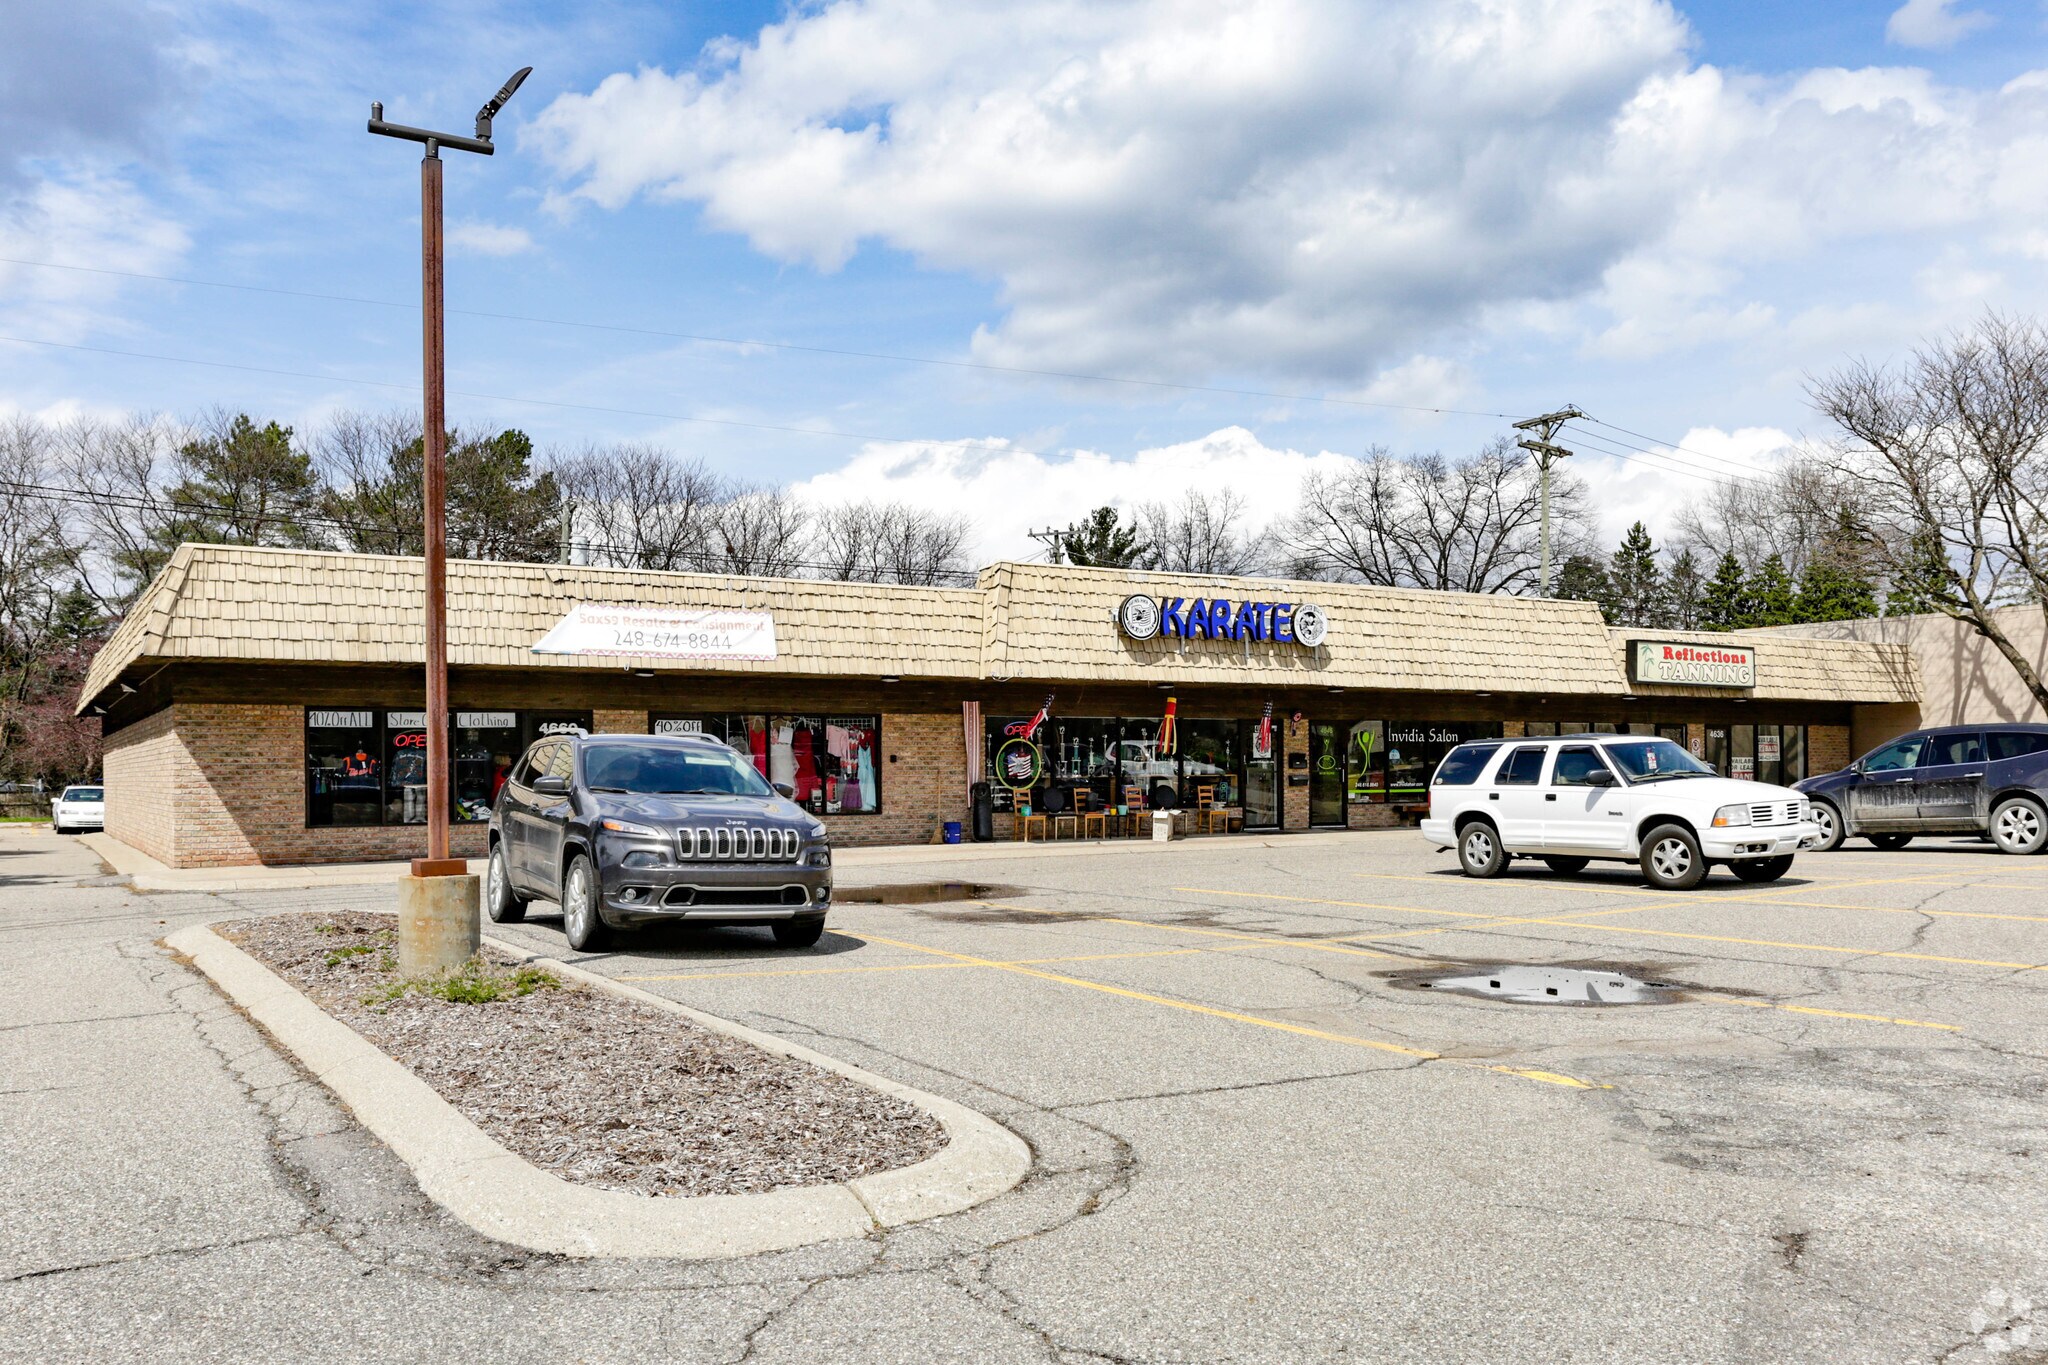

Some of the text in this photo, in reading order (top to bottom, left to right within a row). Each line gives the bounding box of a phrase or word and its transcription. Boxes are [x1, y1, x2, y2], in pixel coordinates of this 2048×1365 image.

[1161, 597, 1293, 642] KARATE
[613, 629, 733, 650] 248-674-8844
[1663, 646, 1746, 664] Reflections
[1658, 662, 1751, 684] TANNING
[390, 712, 420, 727] Store
[458, 714, 509, 728] Clothing
[1006, 726, 1028, 735] OPE
[1388, 728, 1458, 742] Invidia Salon
[395, 735, 428, 747] OPE
